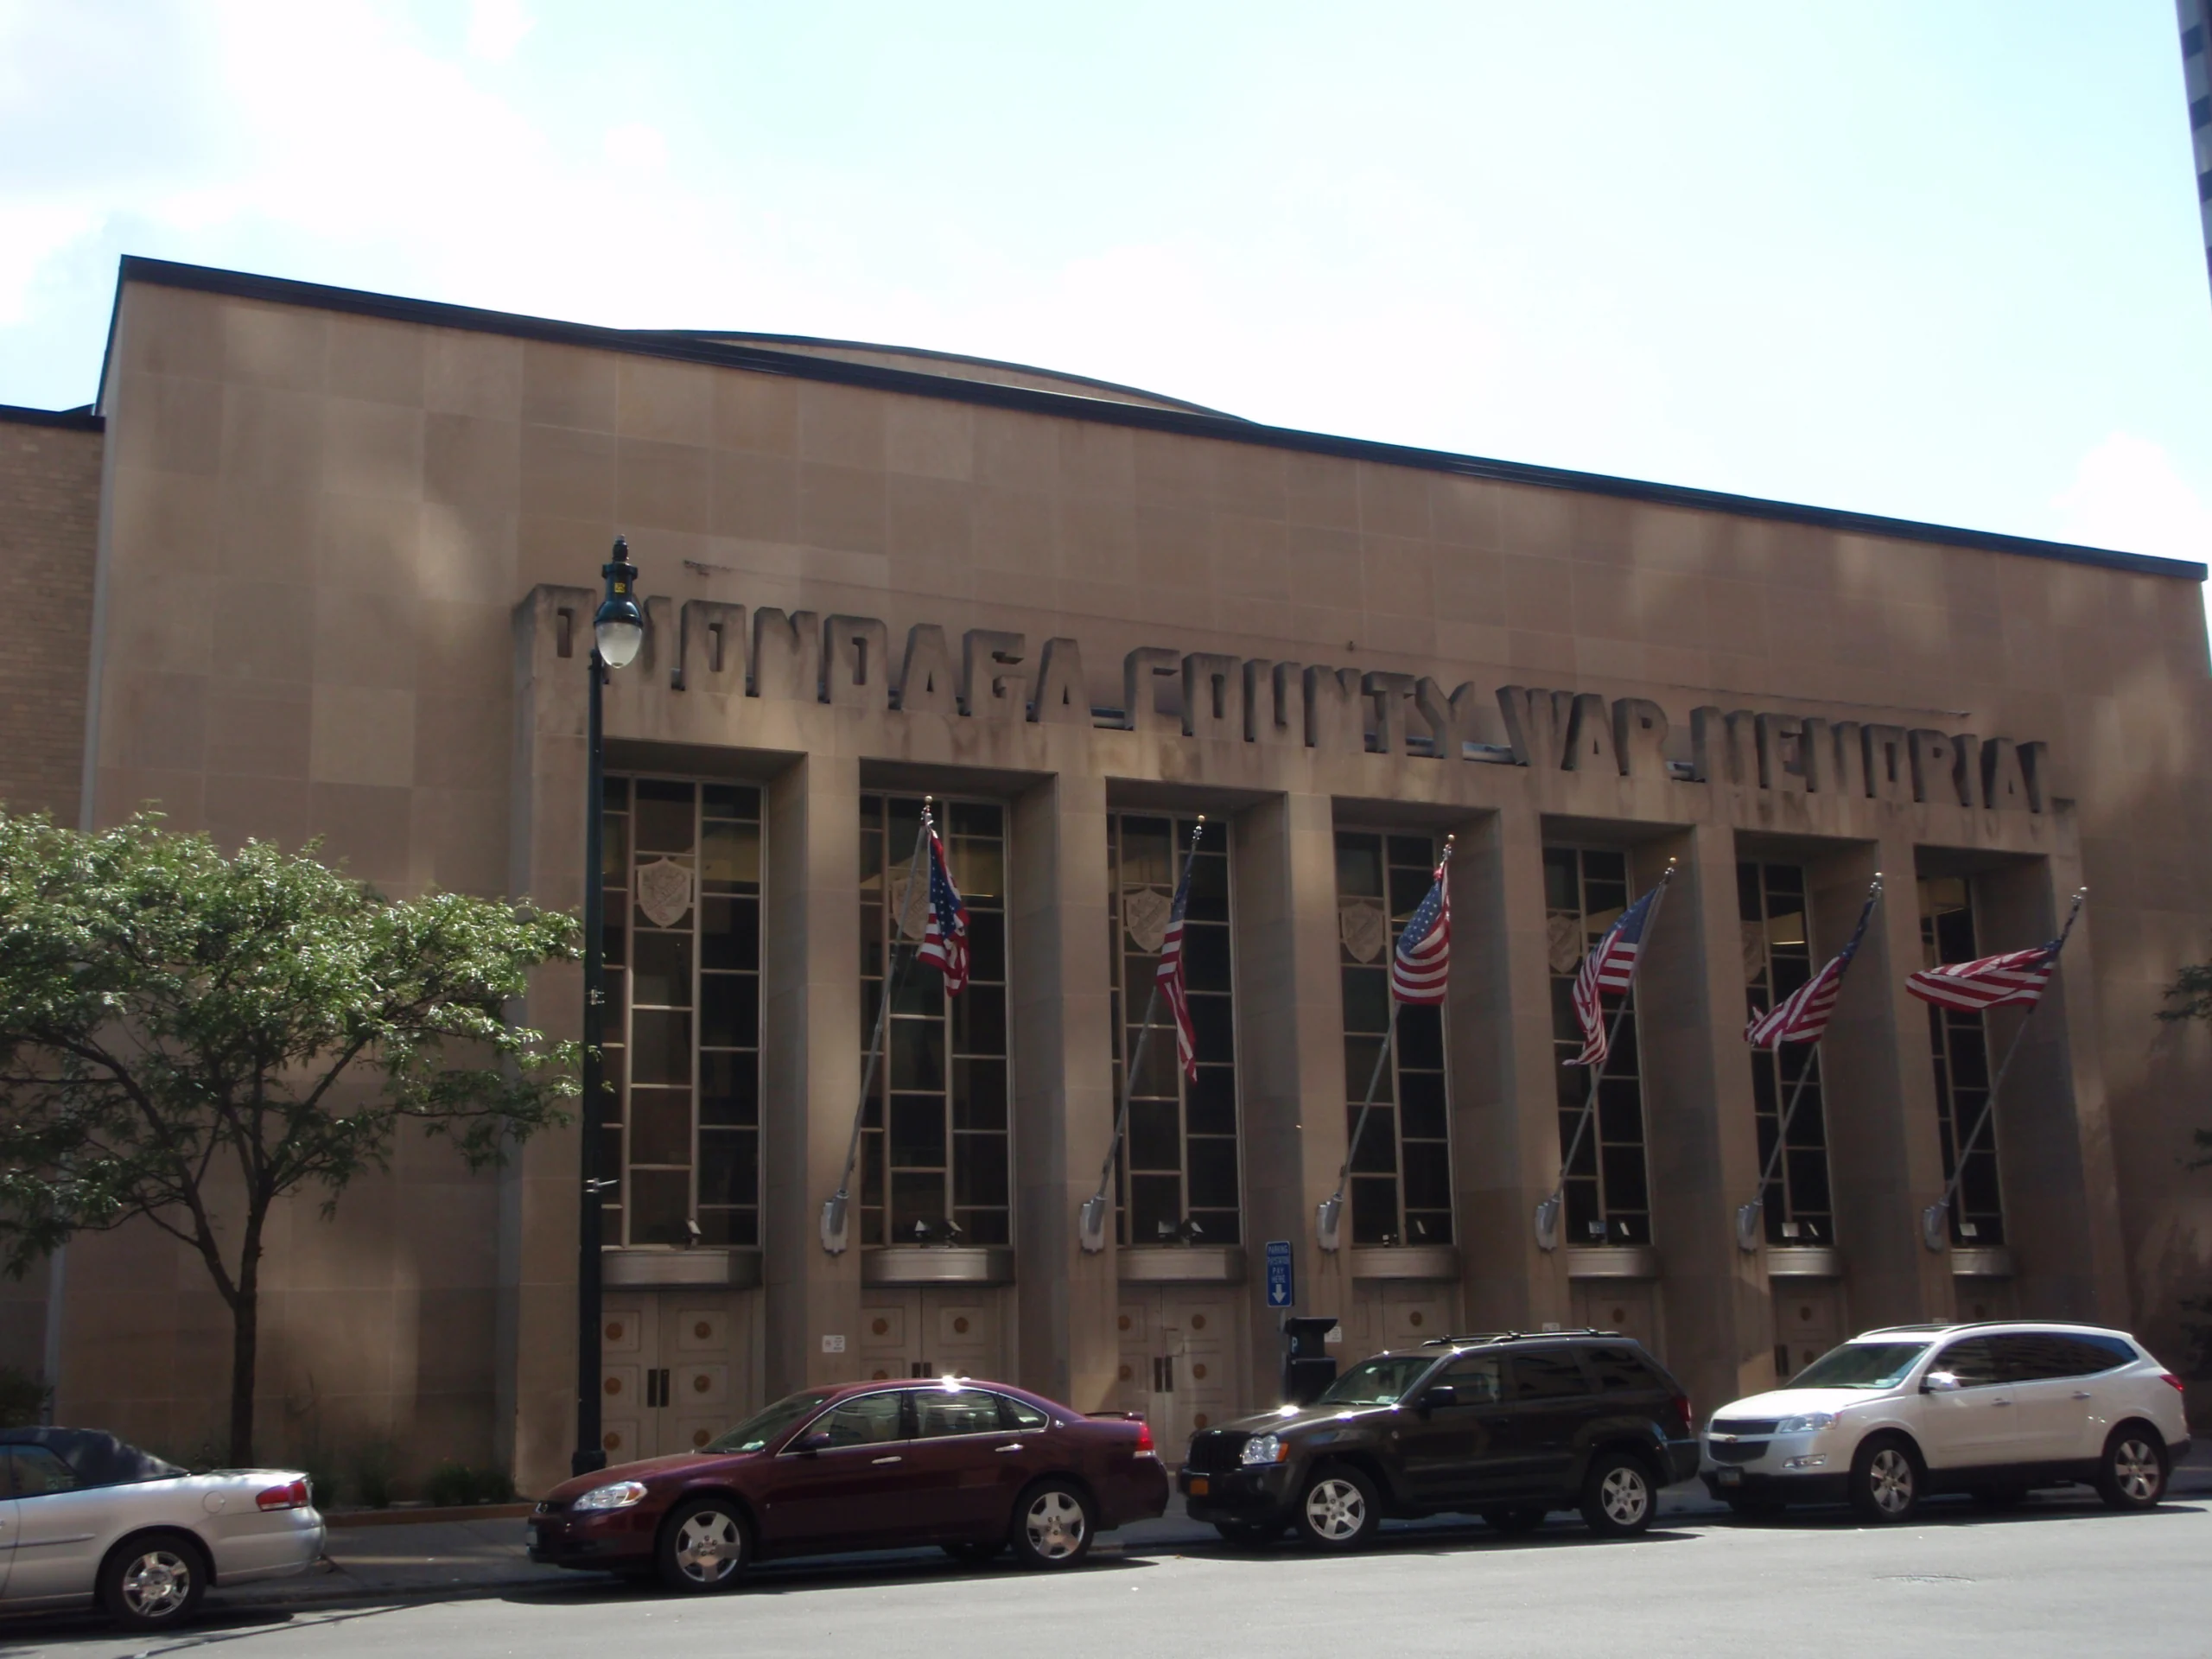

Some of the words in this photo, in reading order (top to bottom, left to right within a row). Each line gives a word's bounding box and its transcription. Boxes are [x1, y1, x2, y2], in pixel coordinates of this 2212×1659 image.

[1124, 646, 1475, 759] COUNTY
[1496, 685, 1669, 778] WAR
[1691, 706, 2075, 816] MEMORIAL
[1271, 1274, 1286, 1283] HERE
[1291, 1336, 1298, 1354] P
